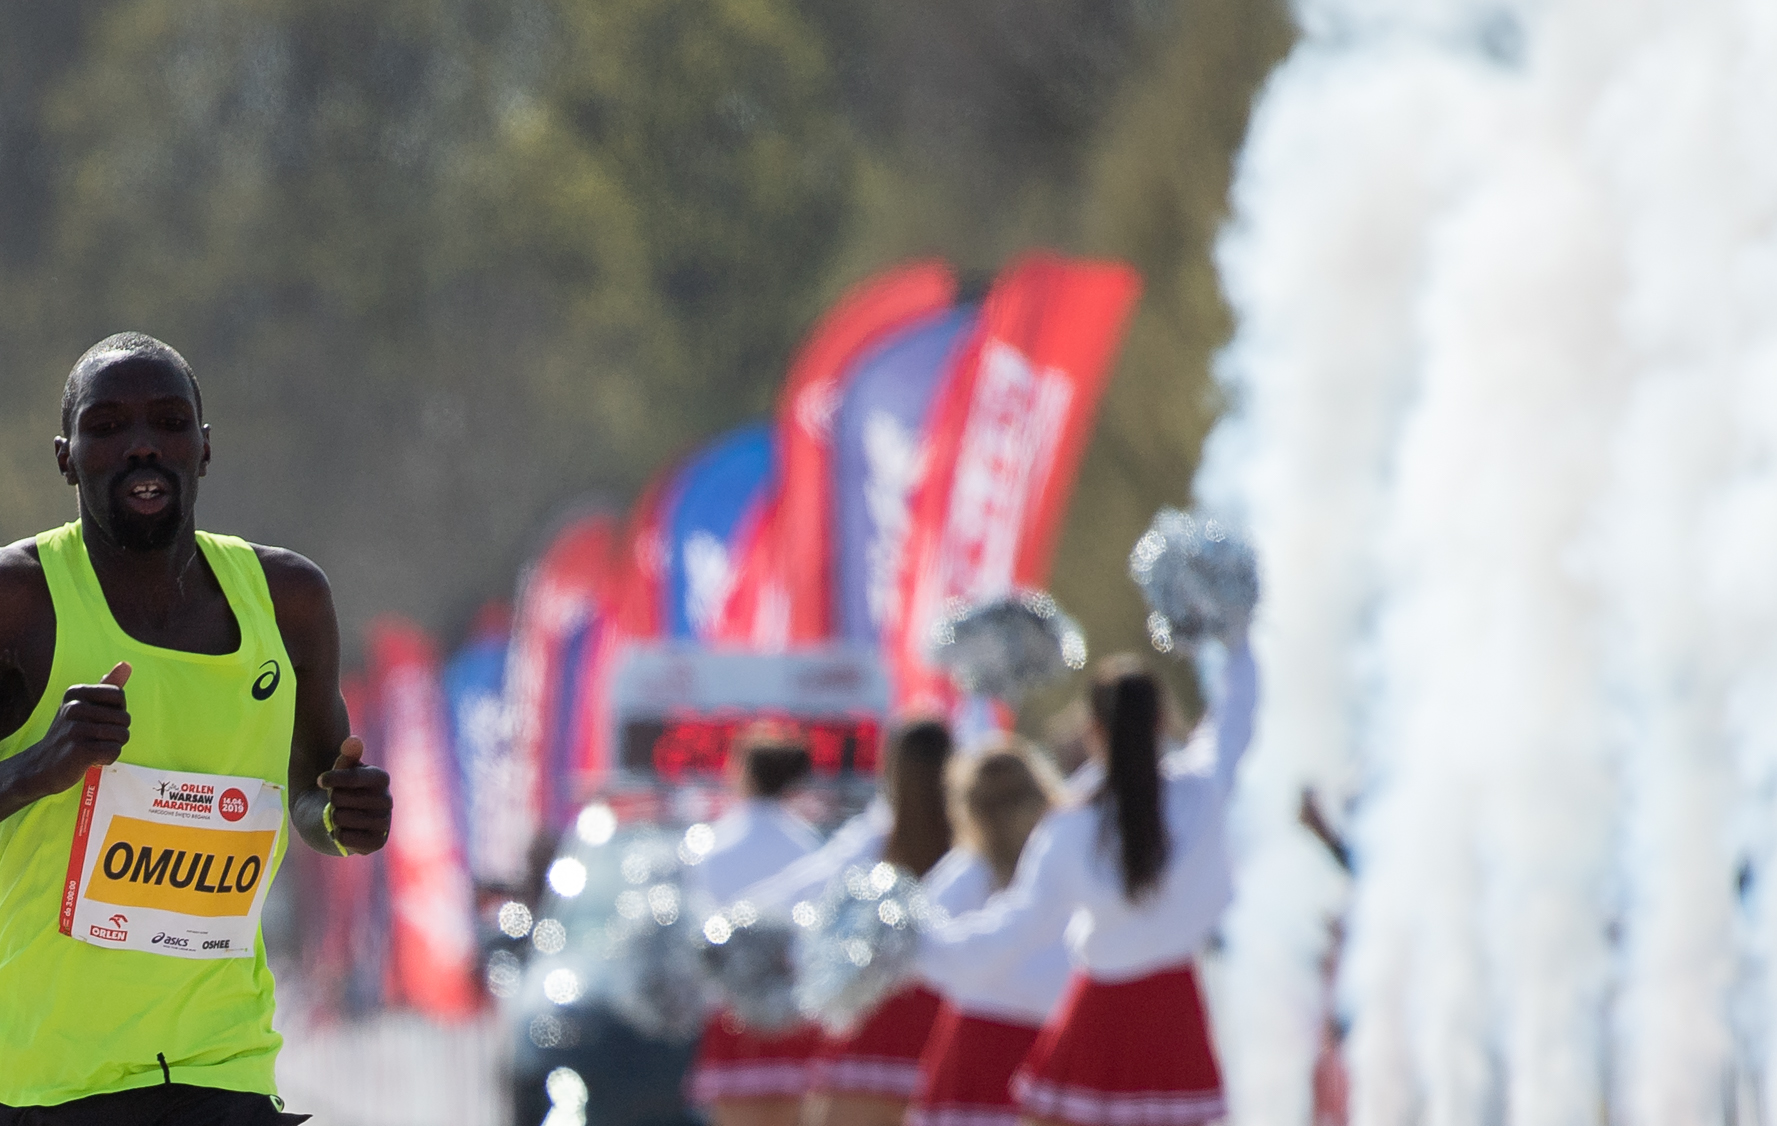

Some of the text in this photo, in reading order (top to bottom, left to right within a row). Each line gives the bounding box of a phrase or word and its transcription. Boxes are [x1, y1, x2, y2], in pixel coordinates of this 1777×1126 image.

[181, 783, 214, 794] ORLEN
[85, 785, 96, 806] ELITE
[169, 791, 214, 804] WARSAW
[153, 799, 212, 813] MARATHON
[222, 804, 244, 813] 2019
[103, 841, 261, 894] OMULLO
[91, 927, 126, 940] ORLEN
[202, 939, 230, 950] OSHEE
